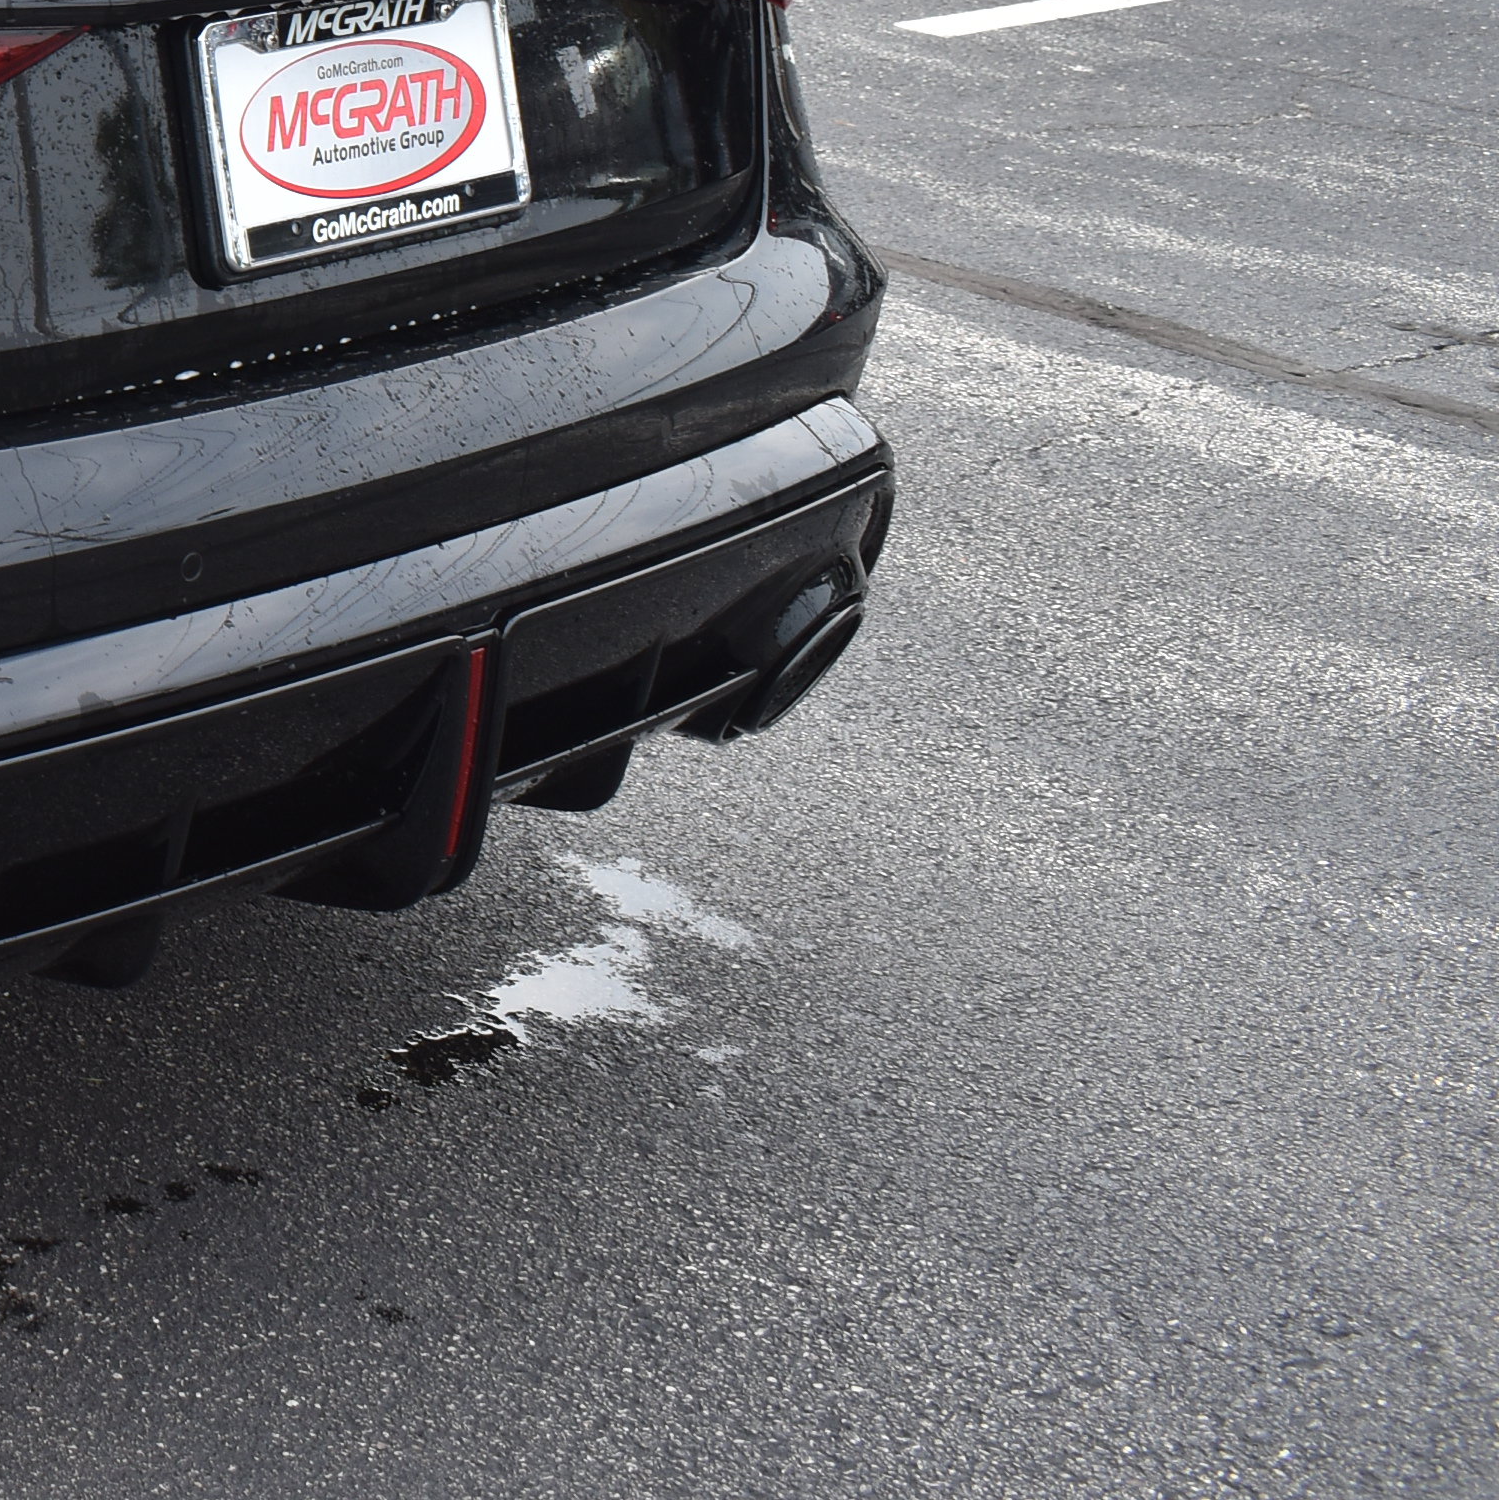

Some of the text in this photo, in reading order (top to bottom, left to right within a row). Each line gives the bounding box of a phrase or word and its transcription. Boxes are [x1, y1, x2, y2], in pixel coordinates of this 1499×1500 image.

[316, 56, 404, 80] GoMcGrath.com
[312, 128, 445, 167] Automotive Group
[312, 193, 461, 243] GoMcGrath.com
